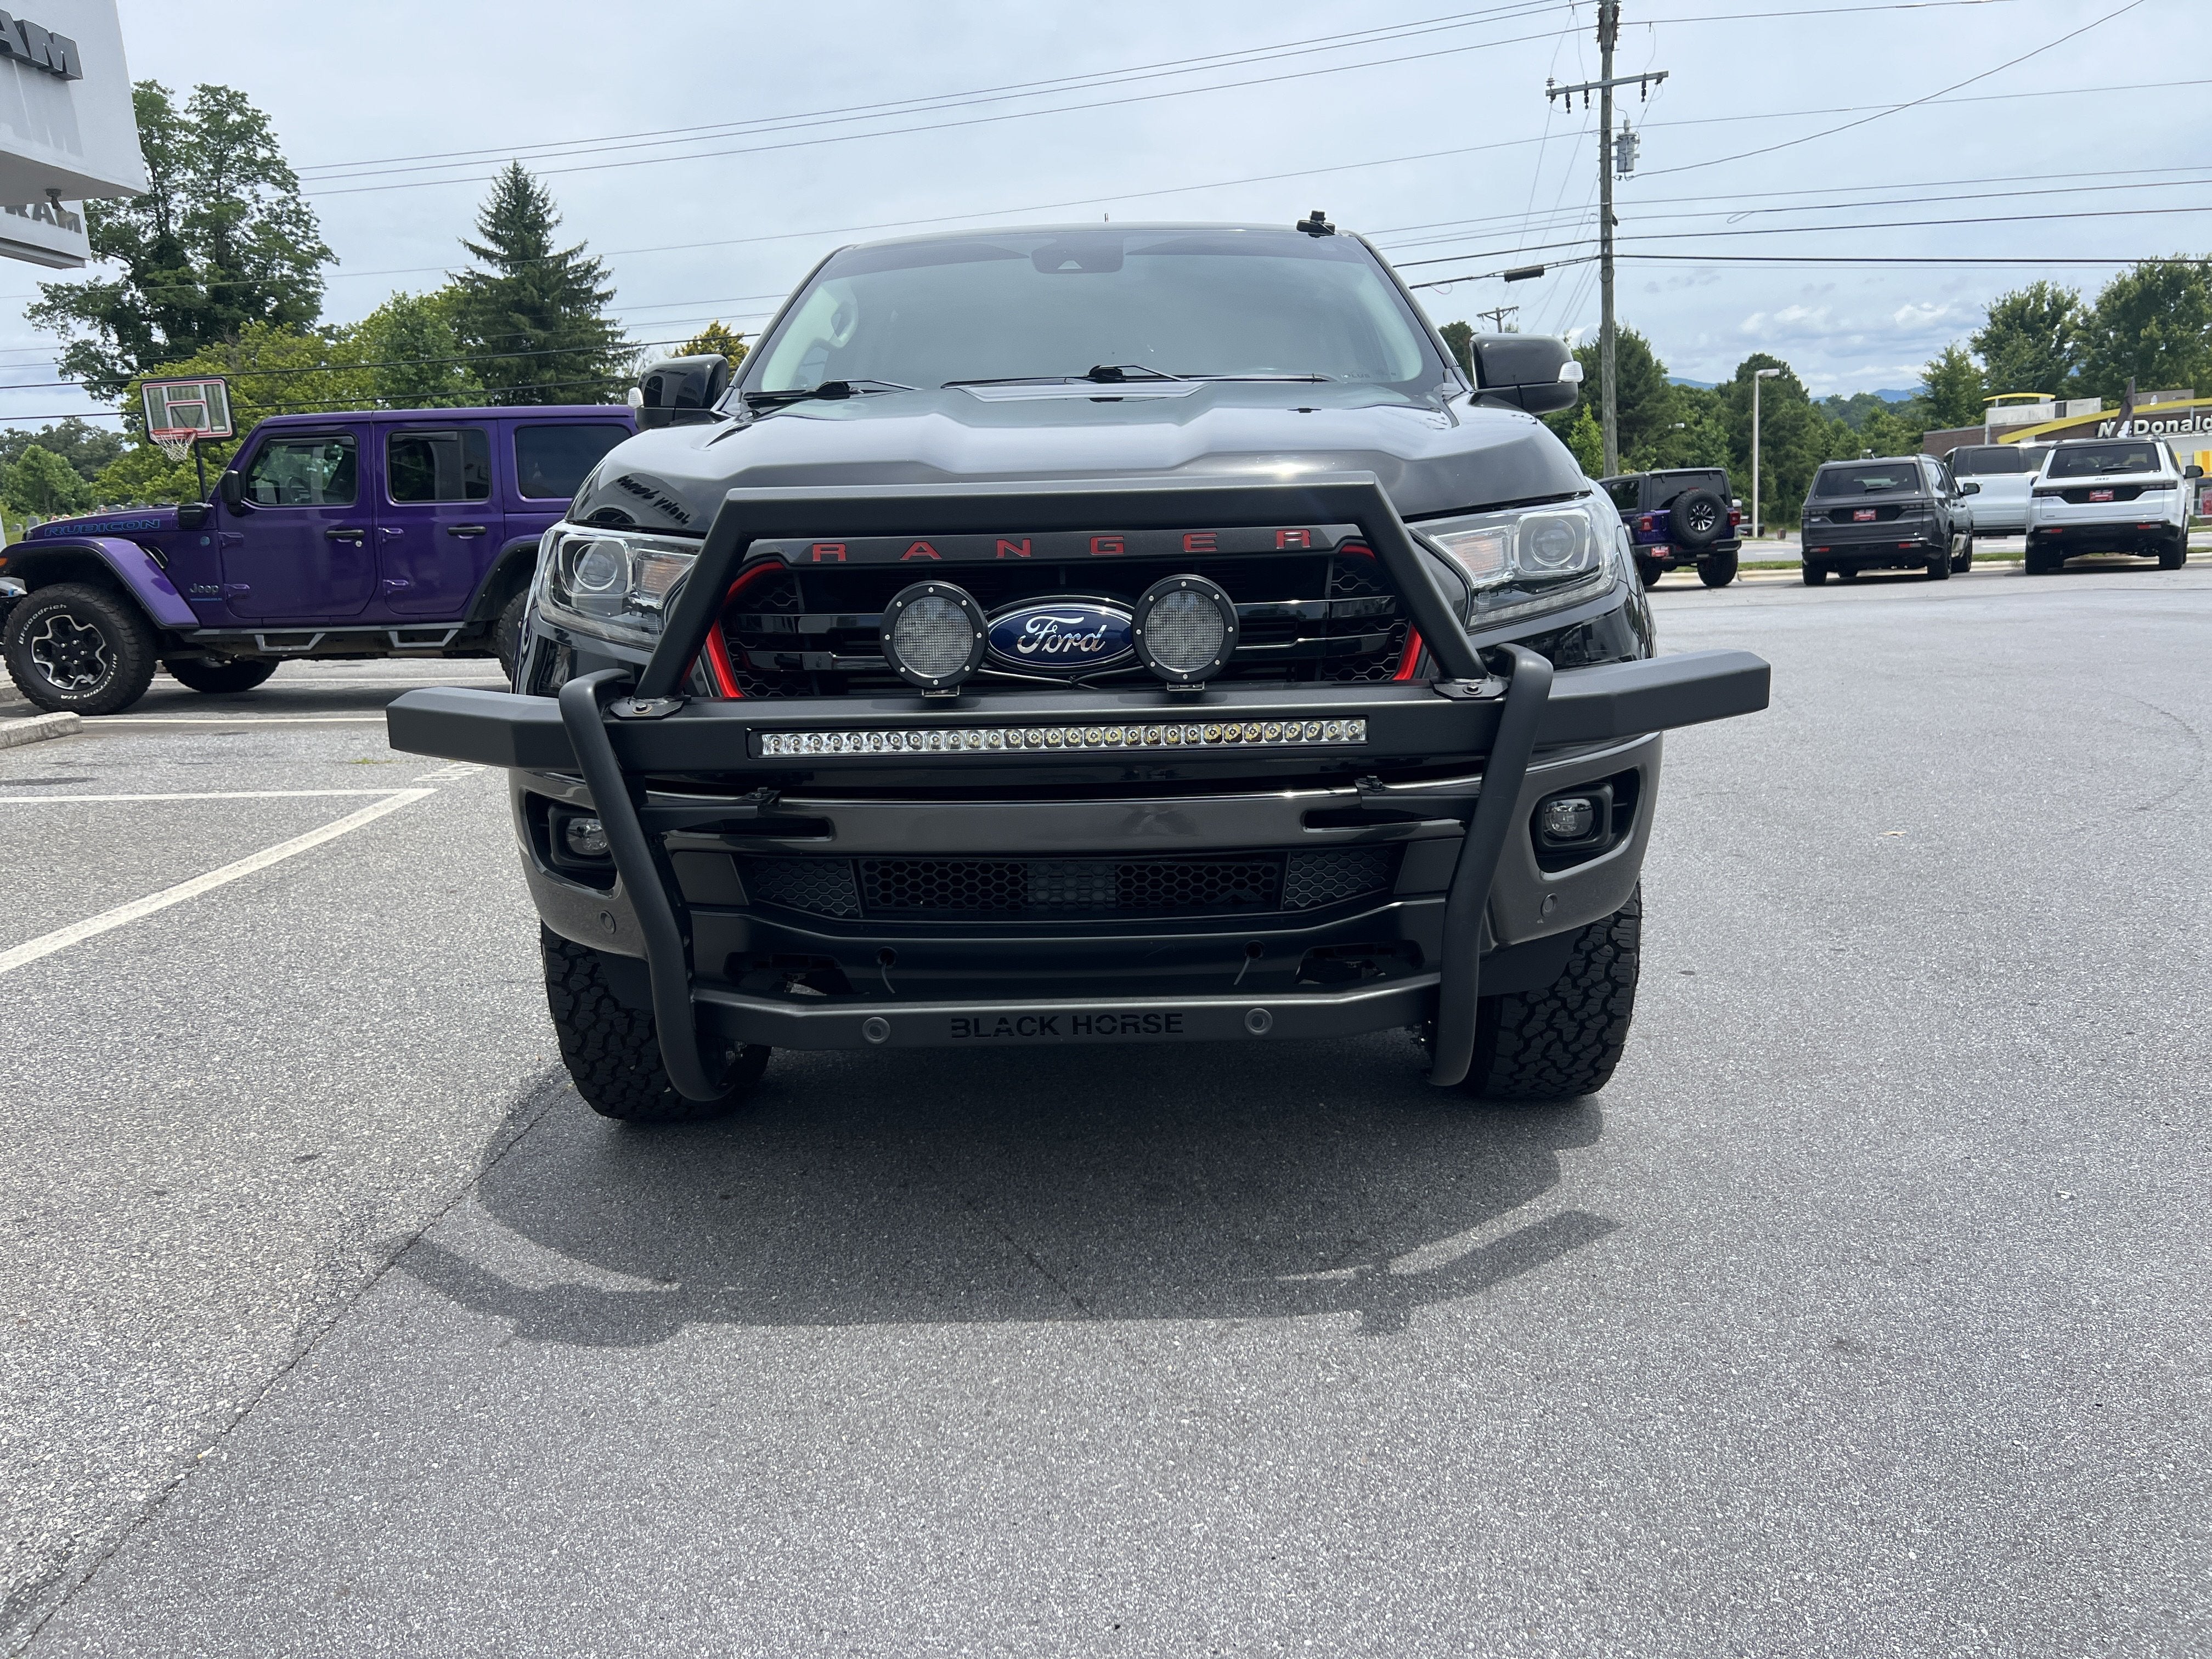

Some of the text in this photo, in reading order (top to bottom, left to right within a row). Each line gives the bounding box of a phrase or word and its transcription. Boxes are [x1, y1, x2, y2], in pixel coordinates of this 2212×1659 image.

[44, 519, 160, 537] RUBICON
[812, 529, 1311, 562] RANGER
[189, 583, 219, 595] Jeep
[18, 604, 66, 645] BFGoodrich
[1017, 616, 1108, 654] Ford
[950, 1013, 1184, 1039] BLACK HORSE
